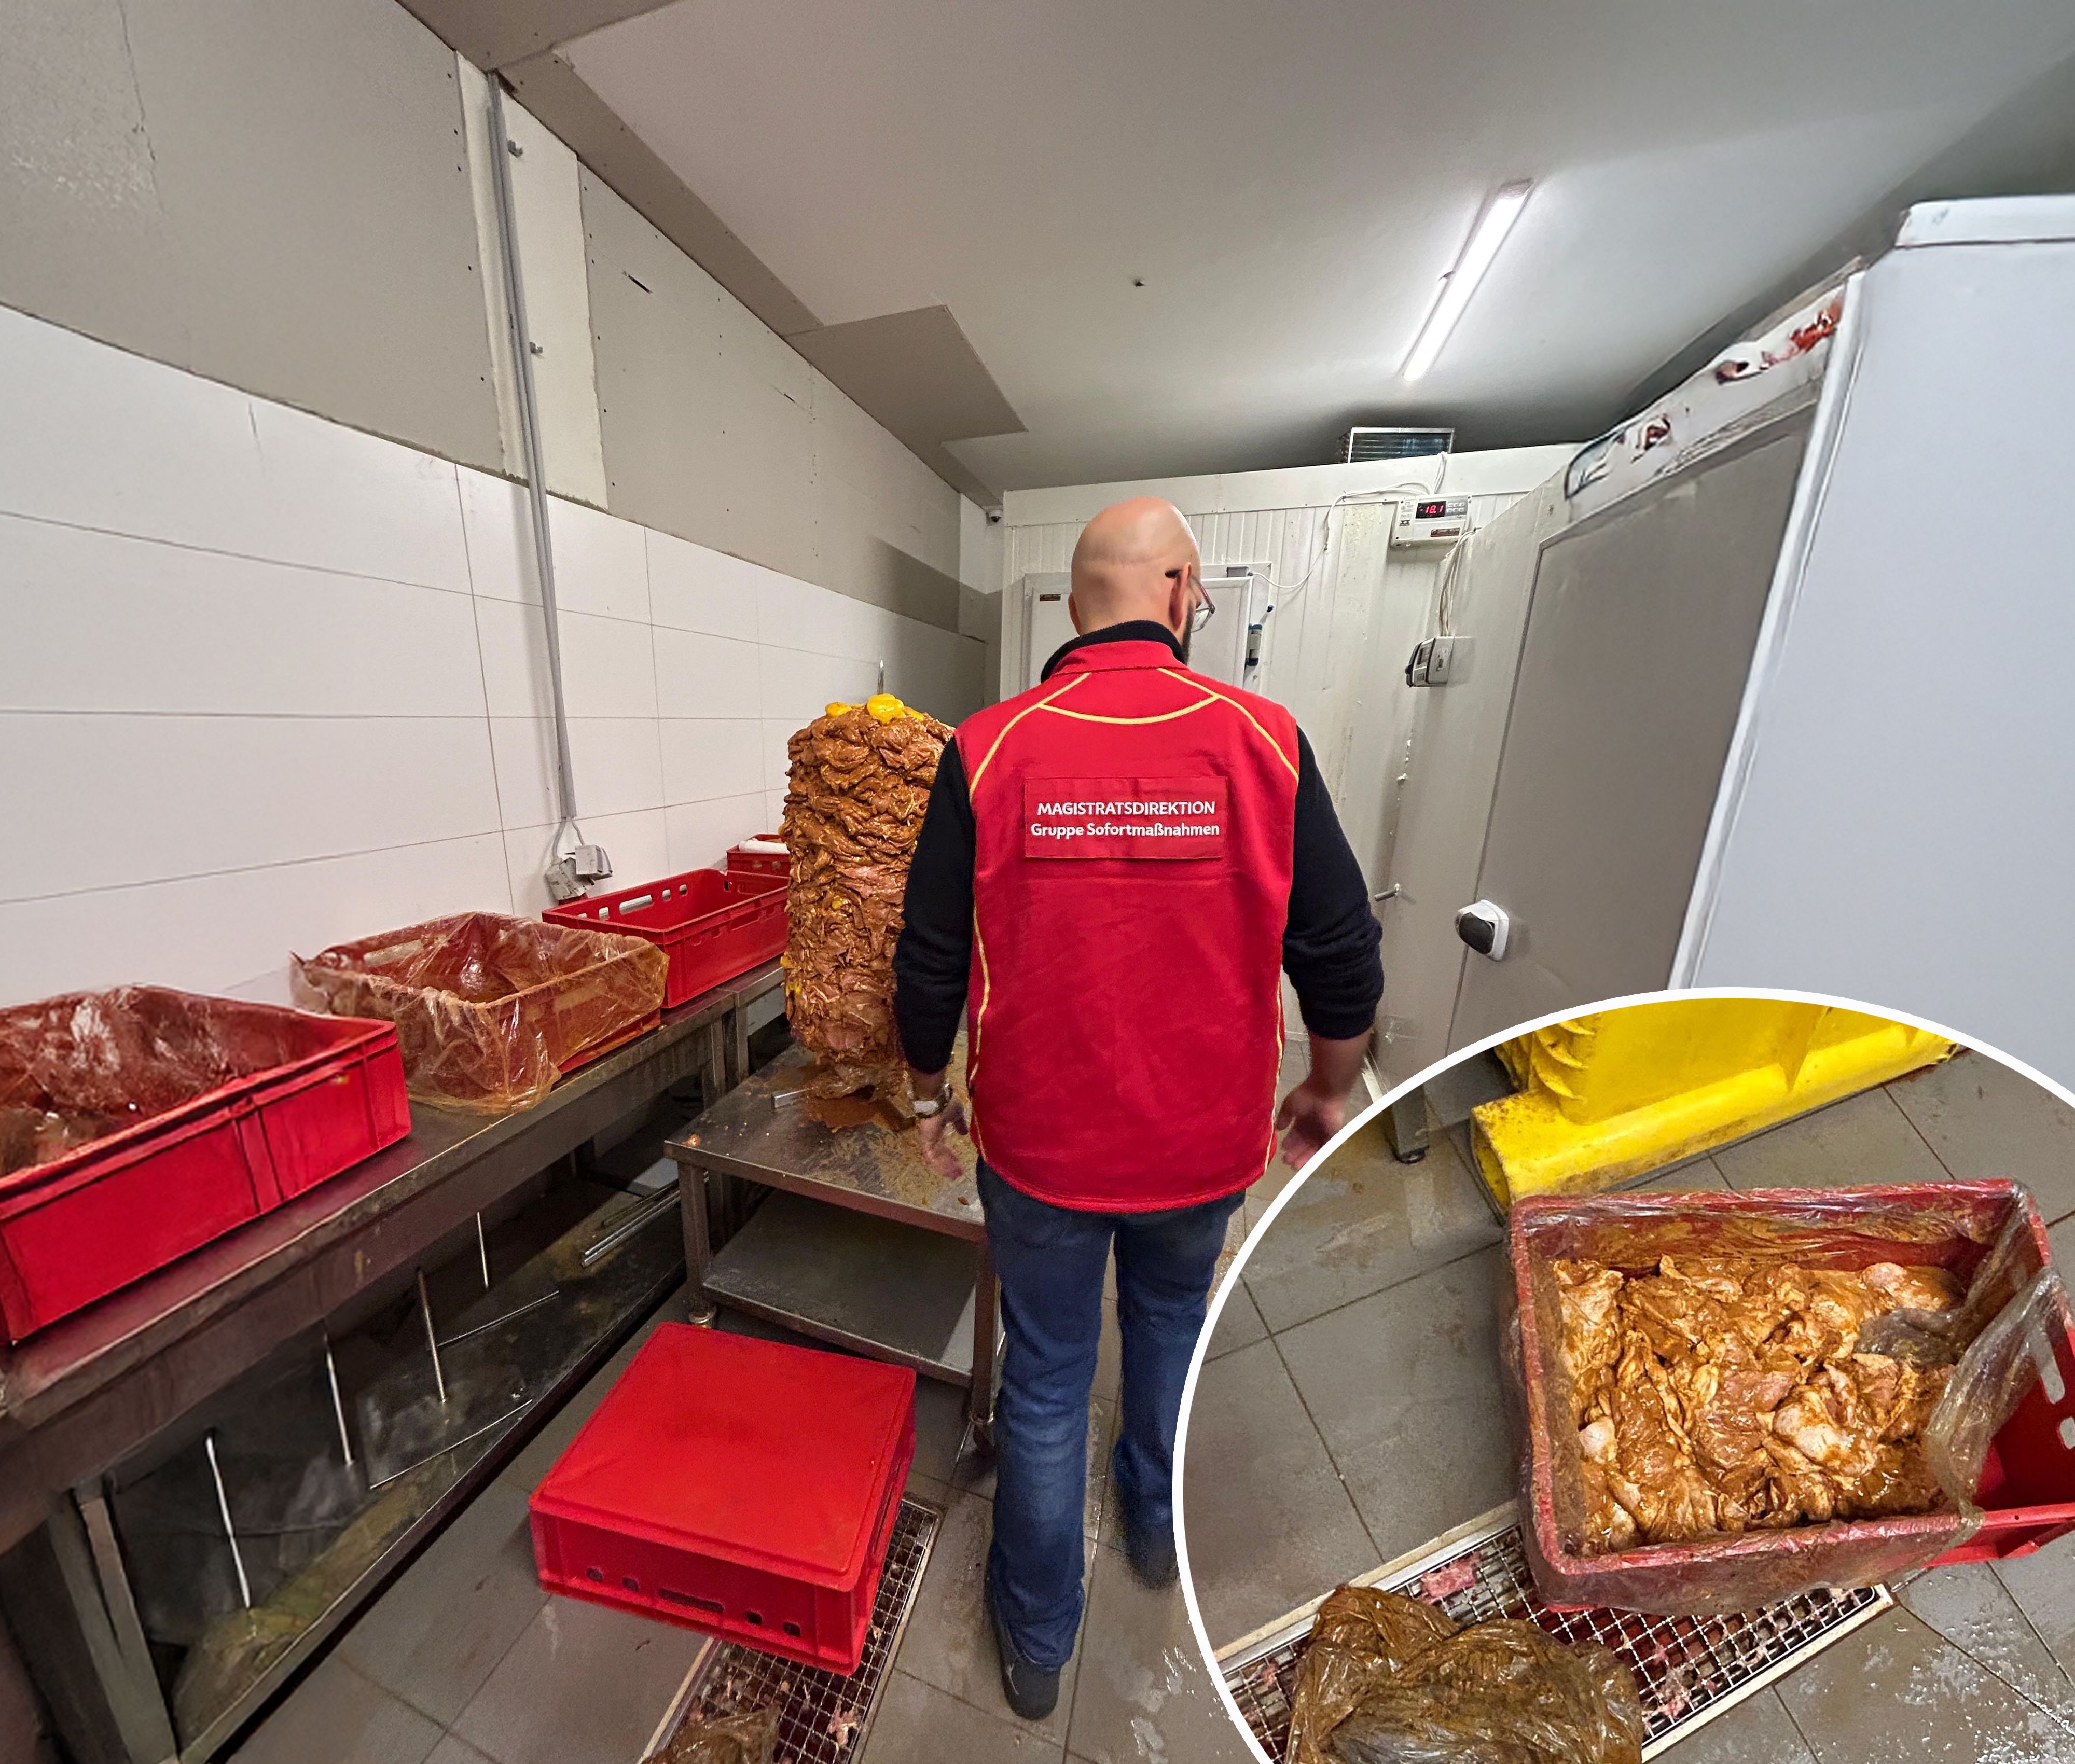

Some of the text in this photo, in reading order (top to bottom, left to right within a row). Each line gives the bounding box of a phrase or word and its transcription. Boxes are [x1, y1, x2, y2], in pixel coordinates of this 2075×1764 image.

[1038, 801, 1215, 815] MAGISTRATSDIREKTION
[1031, 823, 1220, 839] Gruppe Sofortmaßnahmen
